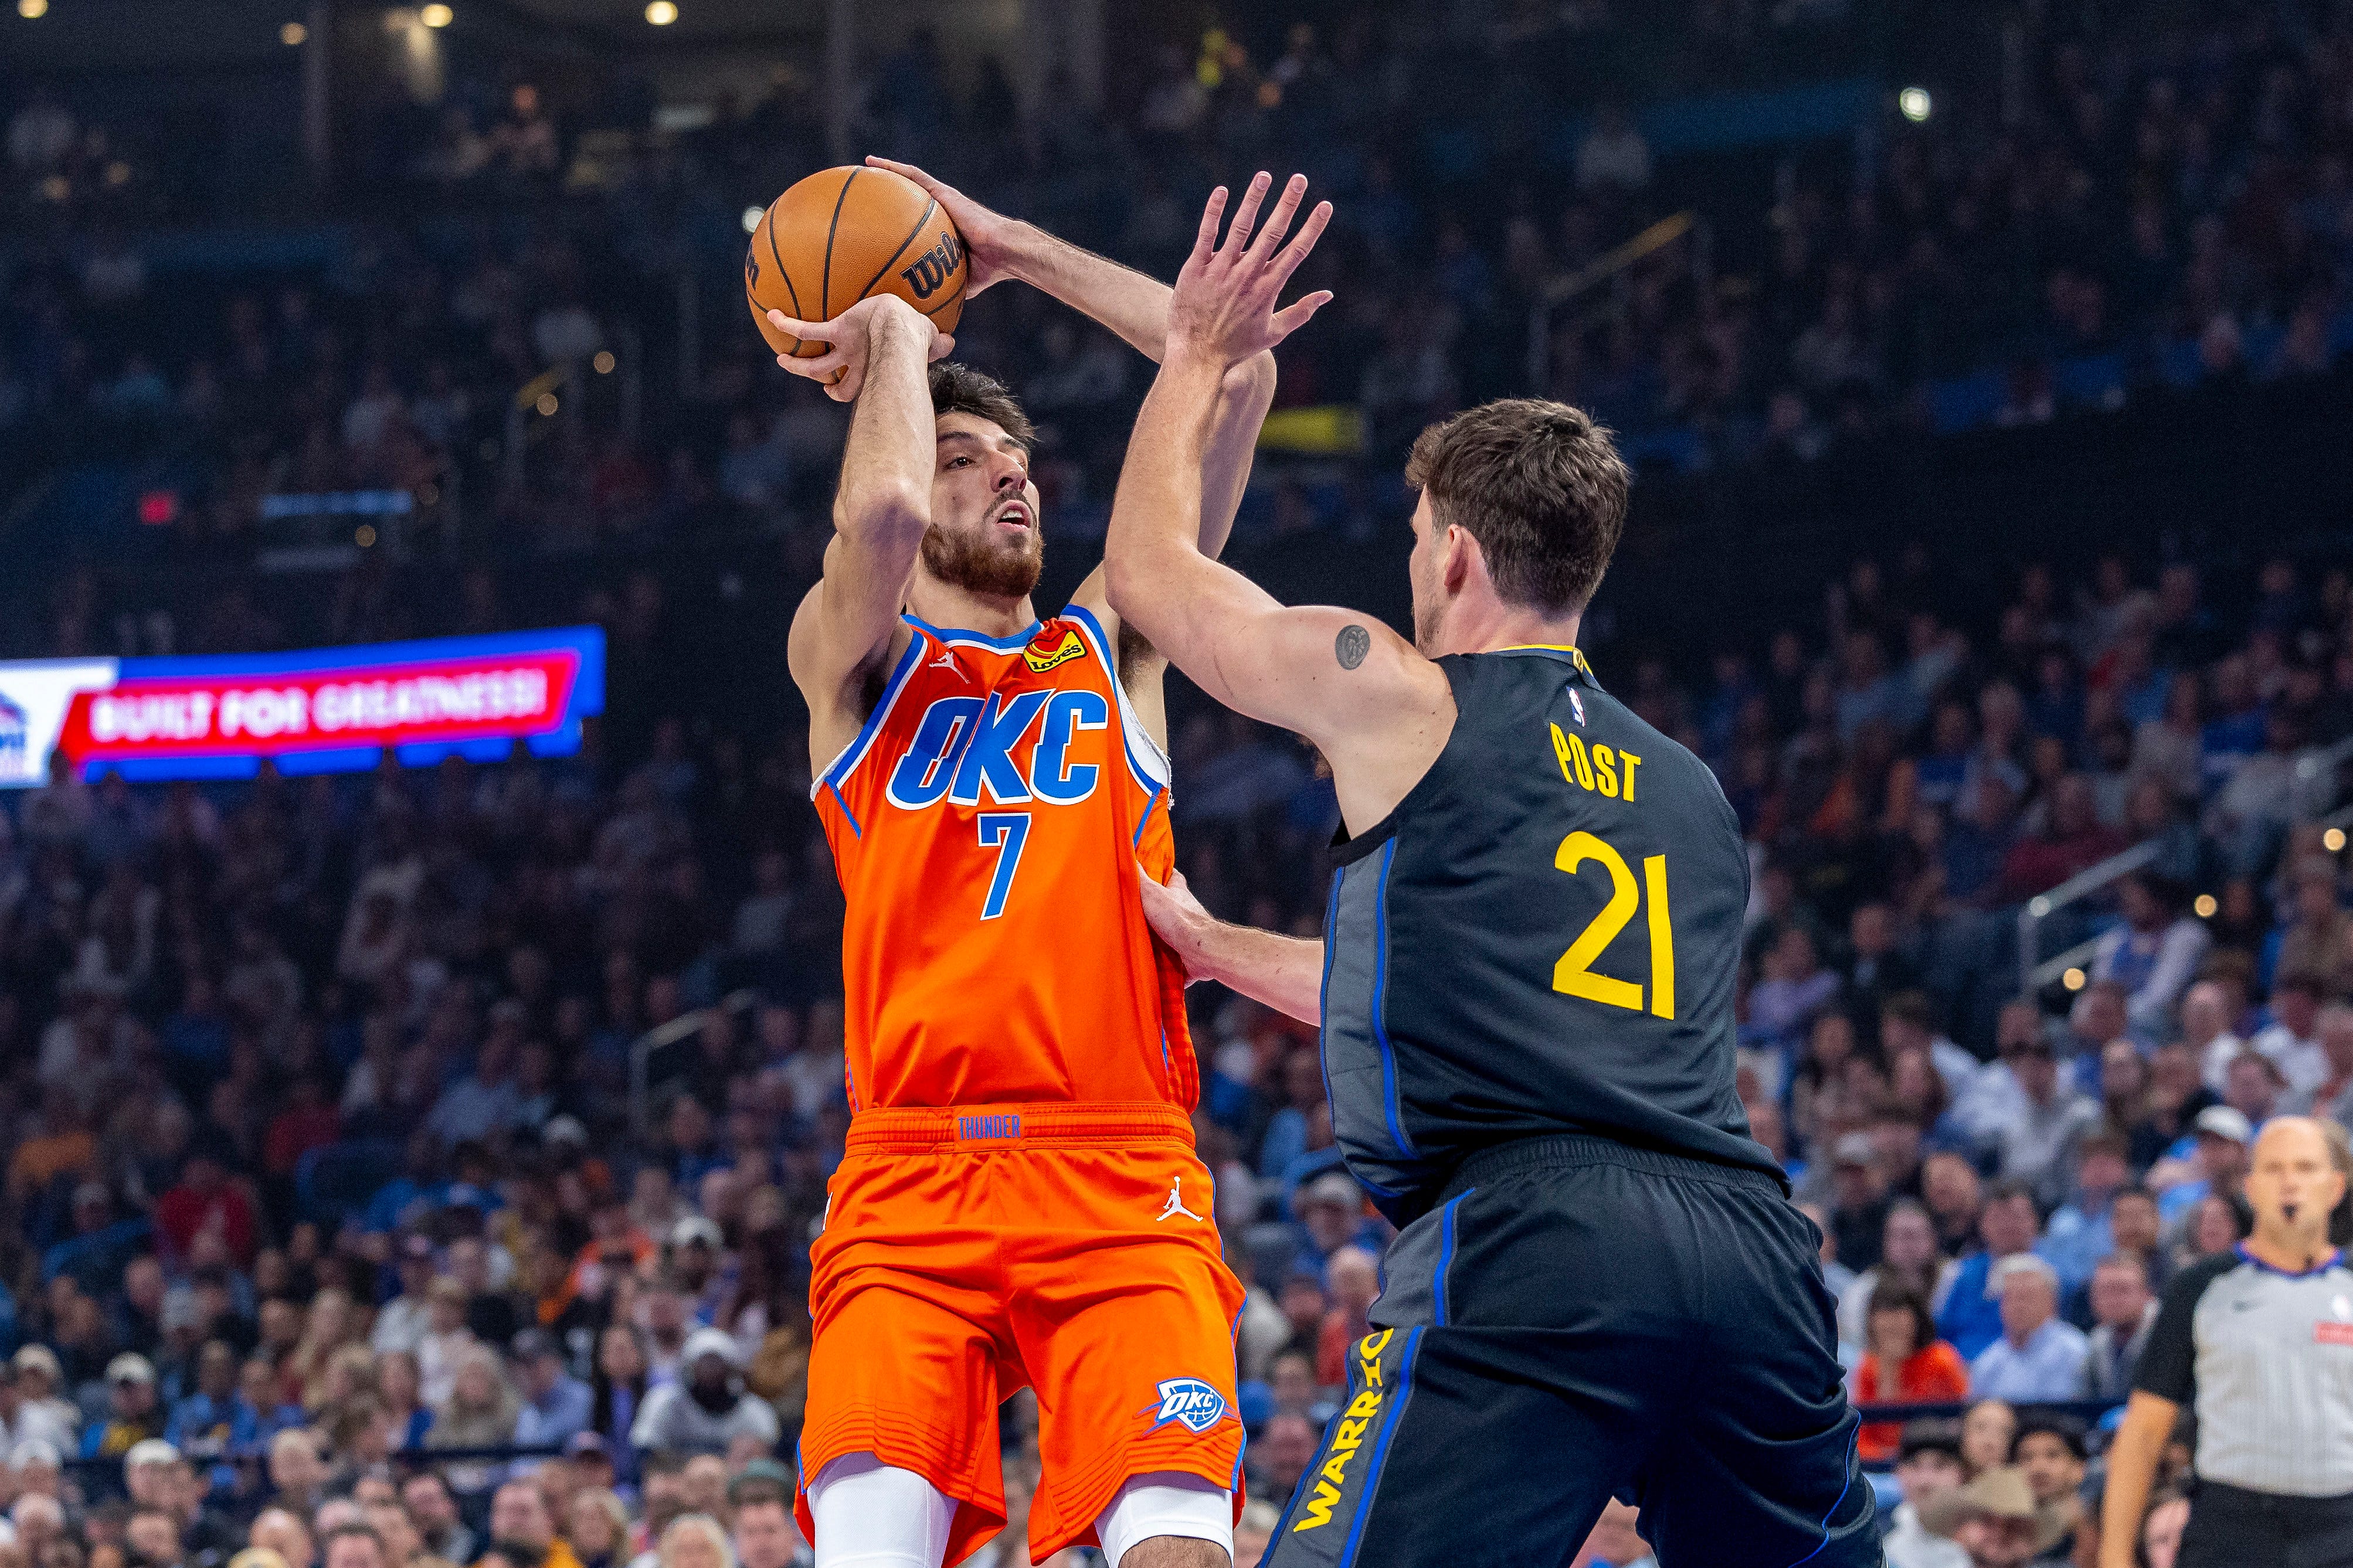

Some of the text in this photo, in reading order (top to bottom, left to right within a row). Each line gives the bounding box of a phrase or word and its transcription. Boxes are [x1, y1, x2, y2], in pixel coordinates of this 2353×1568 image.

[885, 688, 1109, 810] OKC
[1549, 722, 1641, 802] POST
[977, 812, 1031, 920] 7
[1553, 831, 1675, 1020] 21
[958, 1115, 1020, 1140] THUNDER
[1159, 1391, 1214, 1419] OKC
